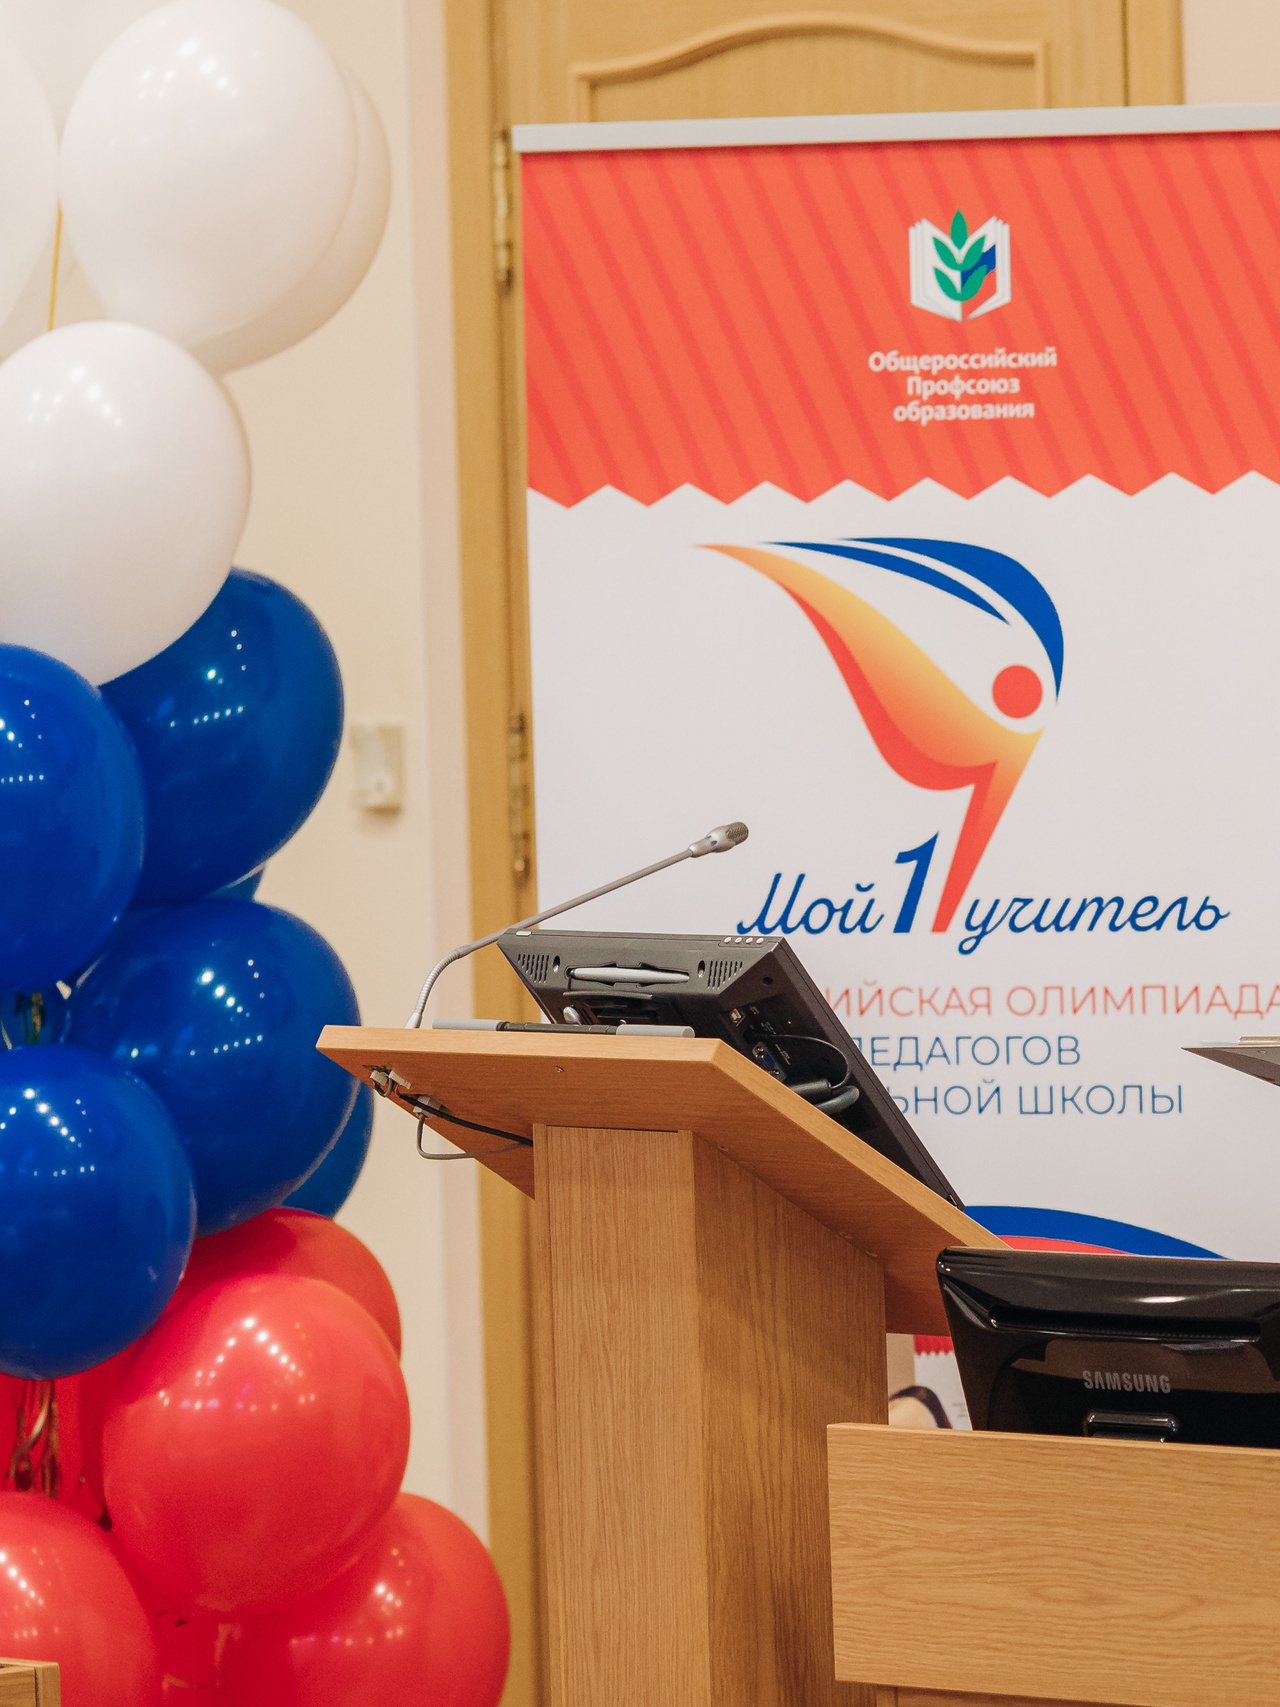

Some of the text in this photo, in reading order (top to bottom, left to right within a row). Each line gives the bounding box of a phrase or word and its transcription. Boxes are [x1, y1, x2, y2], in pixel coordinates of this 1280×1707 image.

[868, 346, 1058, 376] Общероссийский
[906, 374, 1021, 401] Профсоюз
[893, 399, 1035, 426] образования
[736, 872, 885, 936] Мой
[957, 894, 1231, 956] учитель
[1018, 1084, 1183, 1115] ШКОЛЫ
[1082, 1370, 1171, 1394] SAMSUNG
